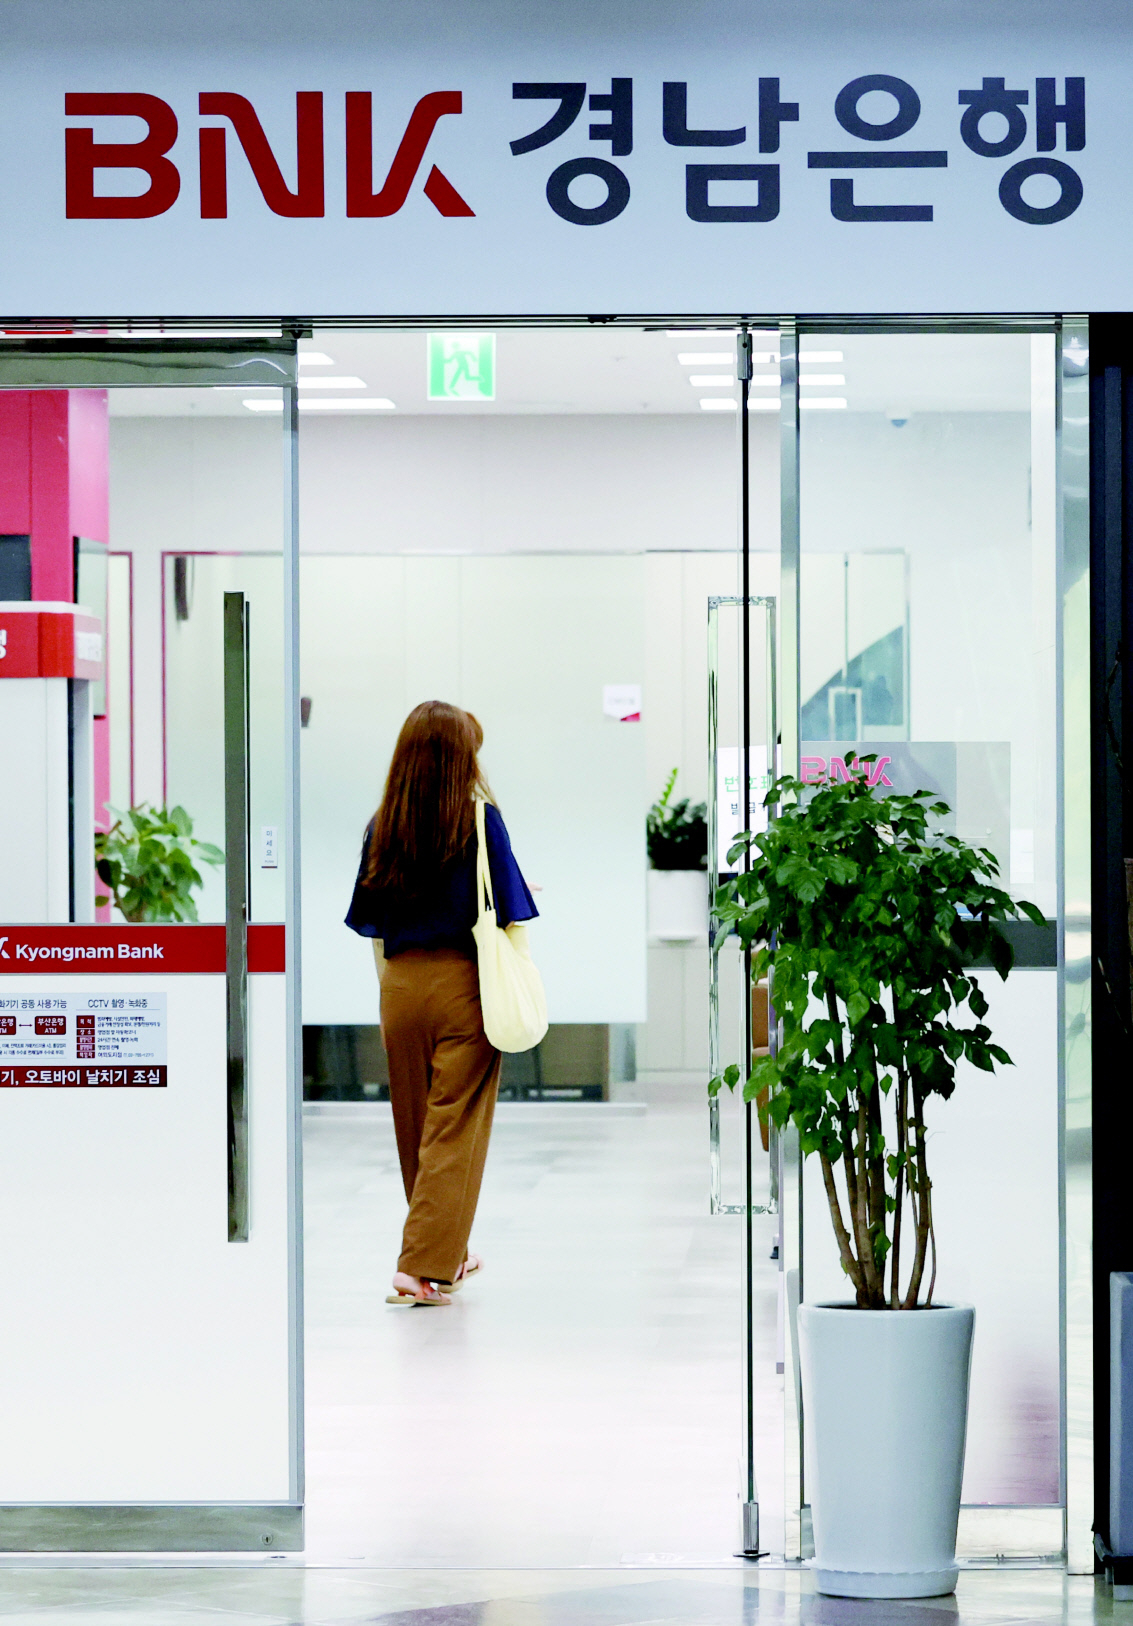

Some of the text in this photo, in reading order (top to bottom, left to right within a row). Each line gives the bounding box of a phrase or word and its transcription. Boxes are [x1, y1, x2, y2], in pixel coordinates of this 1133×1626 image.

[65, 75, 1085, 225] BNK 경남은행
[15, 943, 114, 962] Kyongnam
[117, 943, 164, 959] Bank
[21, 999, 35, 1009] 공동
[37, 999, 52, 1009] 사용
[53, 999, 67, 1009] 가능
[88, 999, 109, 1008] CCTV
[1, 1069, 160, 1086] 기, 오토바이 날치기 조심
